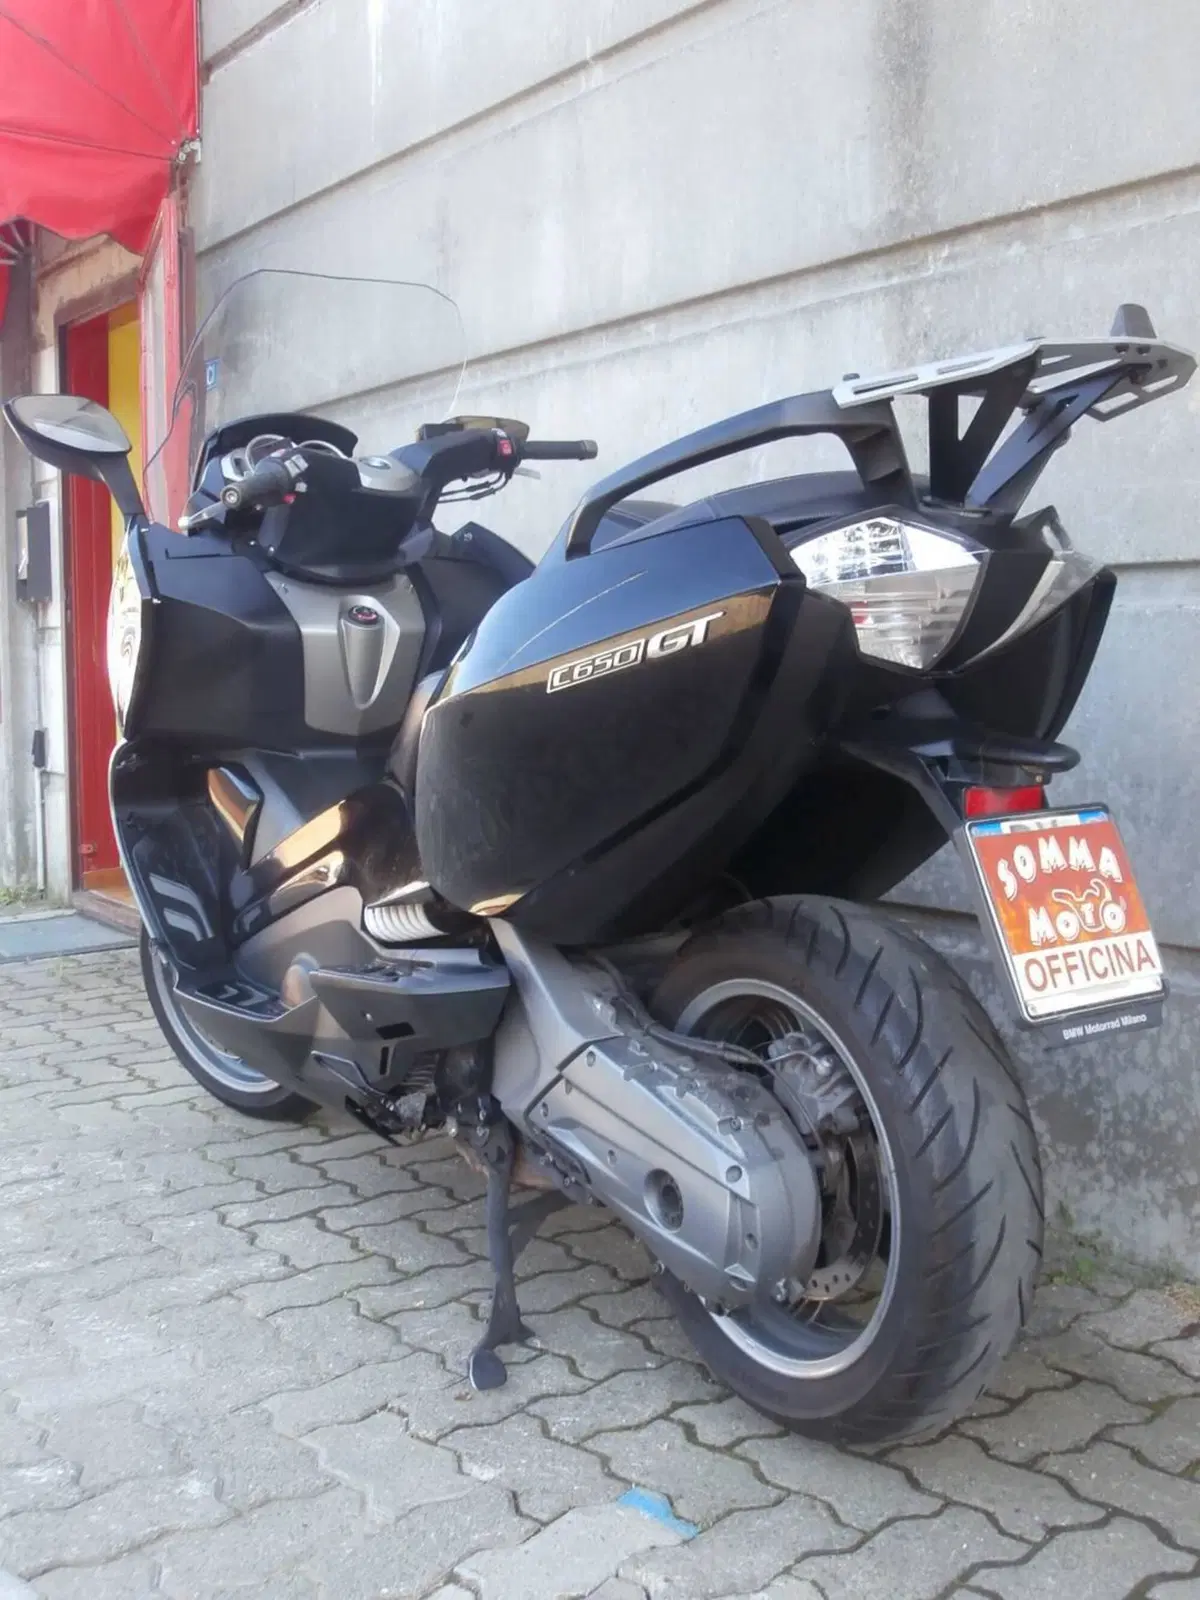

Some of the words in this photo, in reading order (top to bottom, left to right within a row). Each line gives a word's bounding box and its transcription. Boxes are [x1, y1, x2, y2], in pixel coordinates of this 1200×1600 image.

[646, 611, 727, 659] GT
[997, 835, 1123, 901] SOMMA
[1028, 901, 1127, 946] MOTO
[1024, 938, 1157, 993] OFFICINA
[1062, 1026, 1084, 1040] BMW
[1084, 1018, 1120, 1035] Motorrad
[1120, 1013, 1147, 1026] Milano
